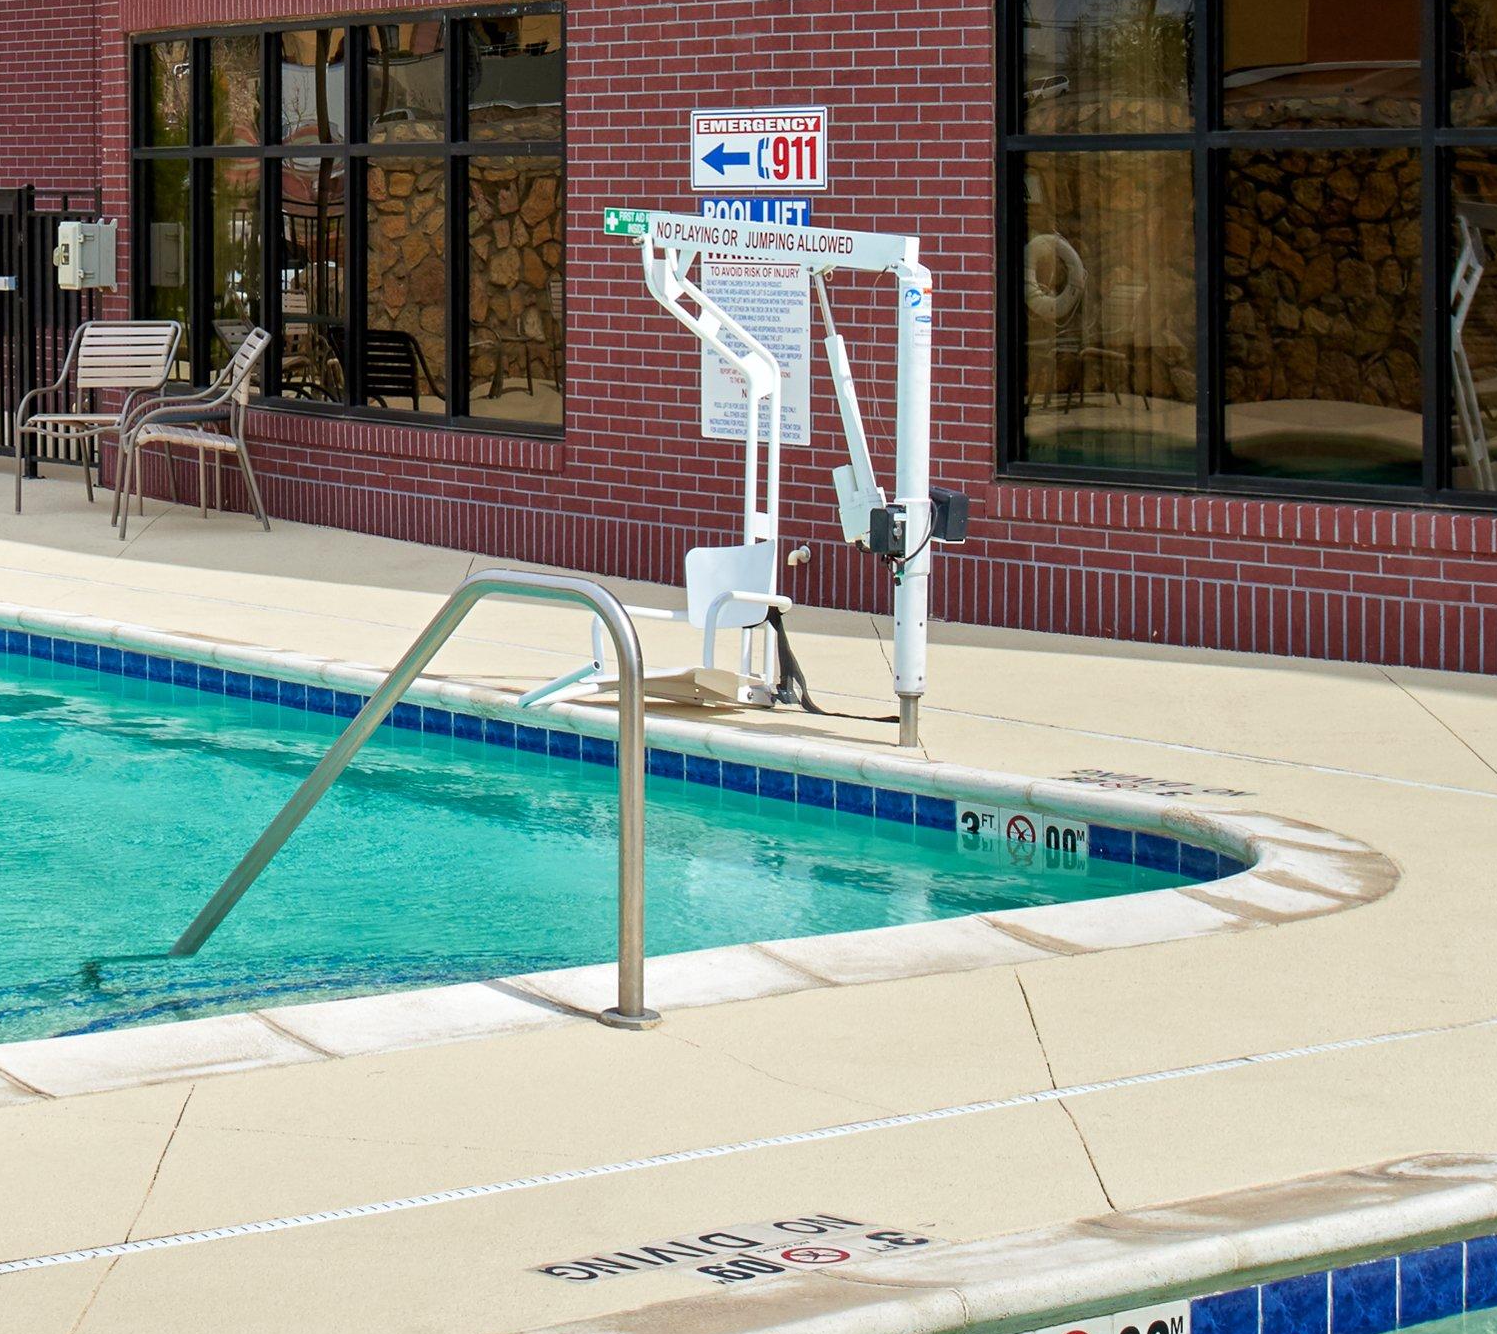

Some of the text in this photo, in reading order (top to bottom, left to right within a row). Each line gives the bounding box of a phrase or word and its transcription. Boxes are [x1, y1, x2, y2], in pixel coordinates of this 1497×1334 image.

[698, 117, 818, 134] EMERGENCY
[772, 136, 817, 180] 911
[657, 221, 853, 255] NO PLAYING OR JUMPING ALLOWED
[710, 266, 800, 279] TO AVOID RISK OF INJURY
[539, 1214, 865, 1281] NO DIVING
